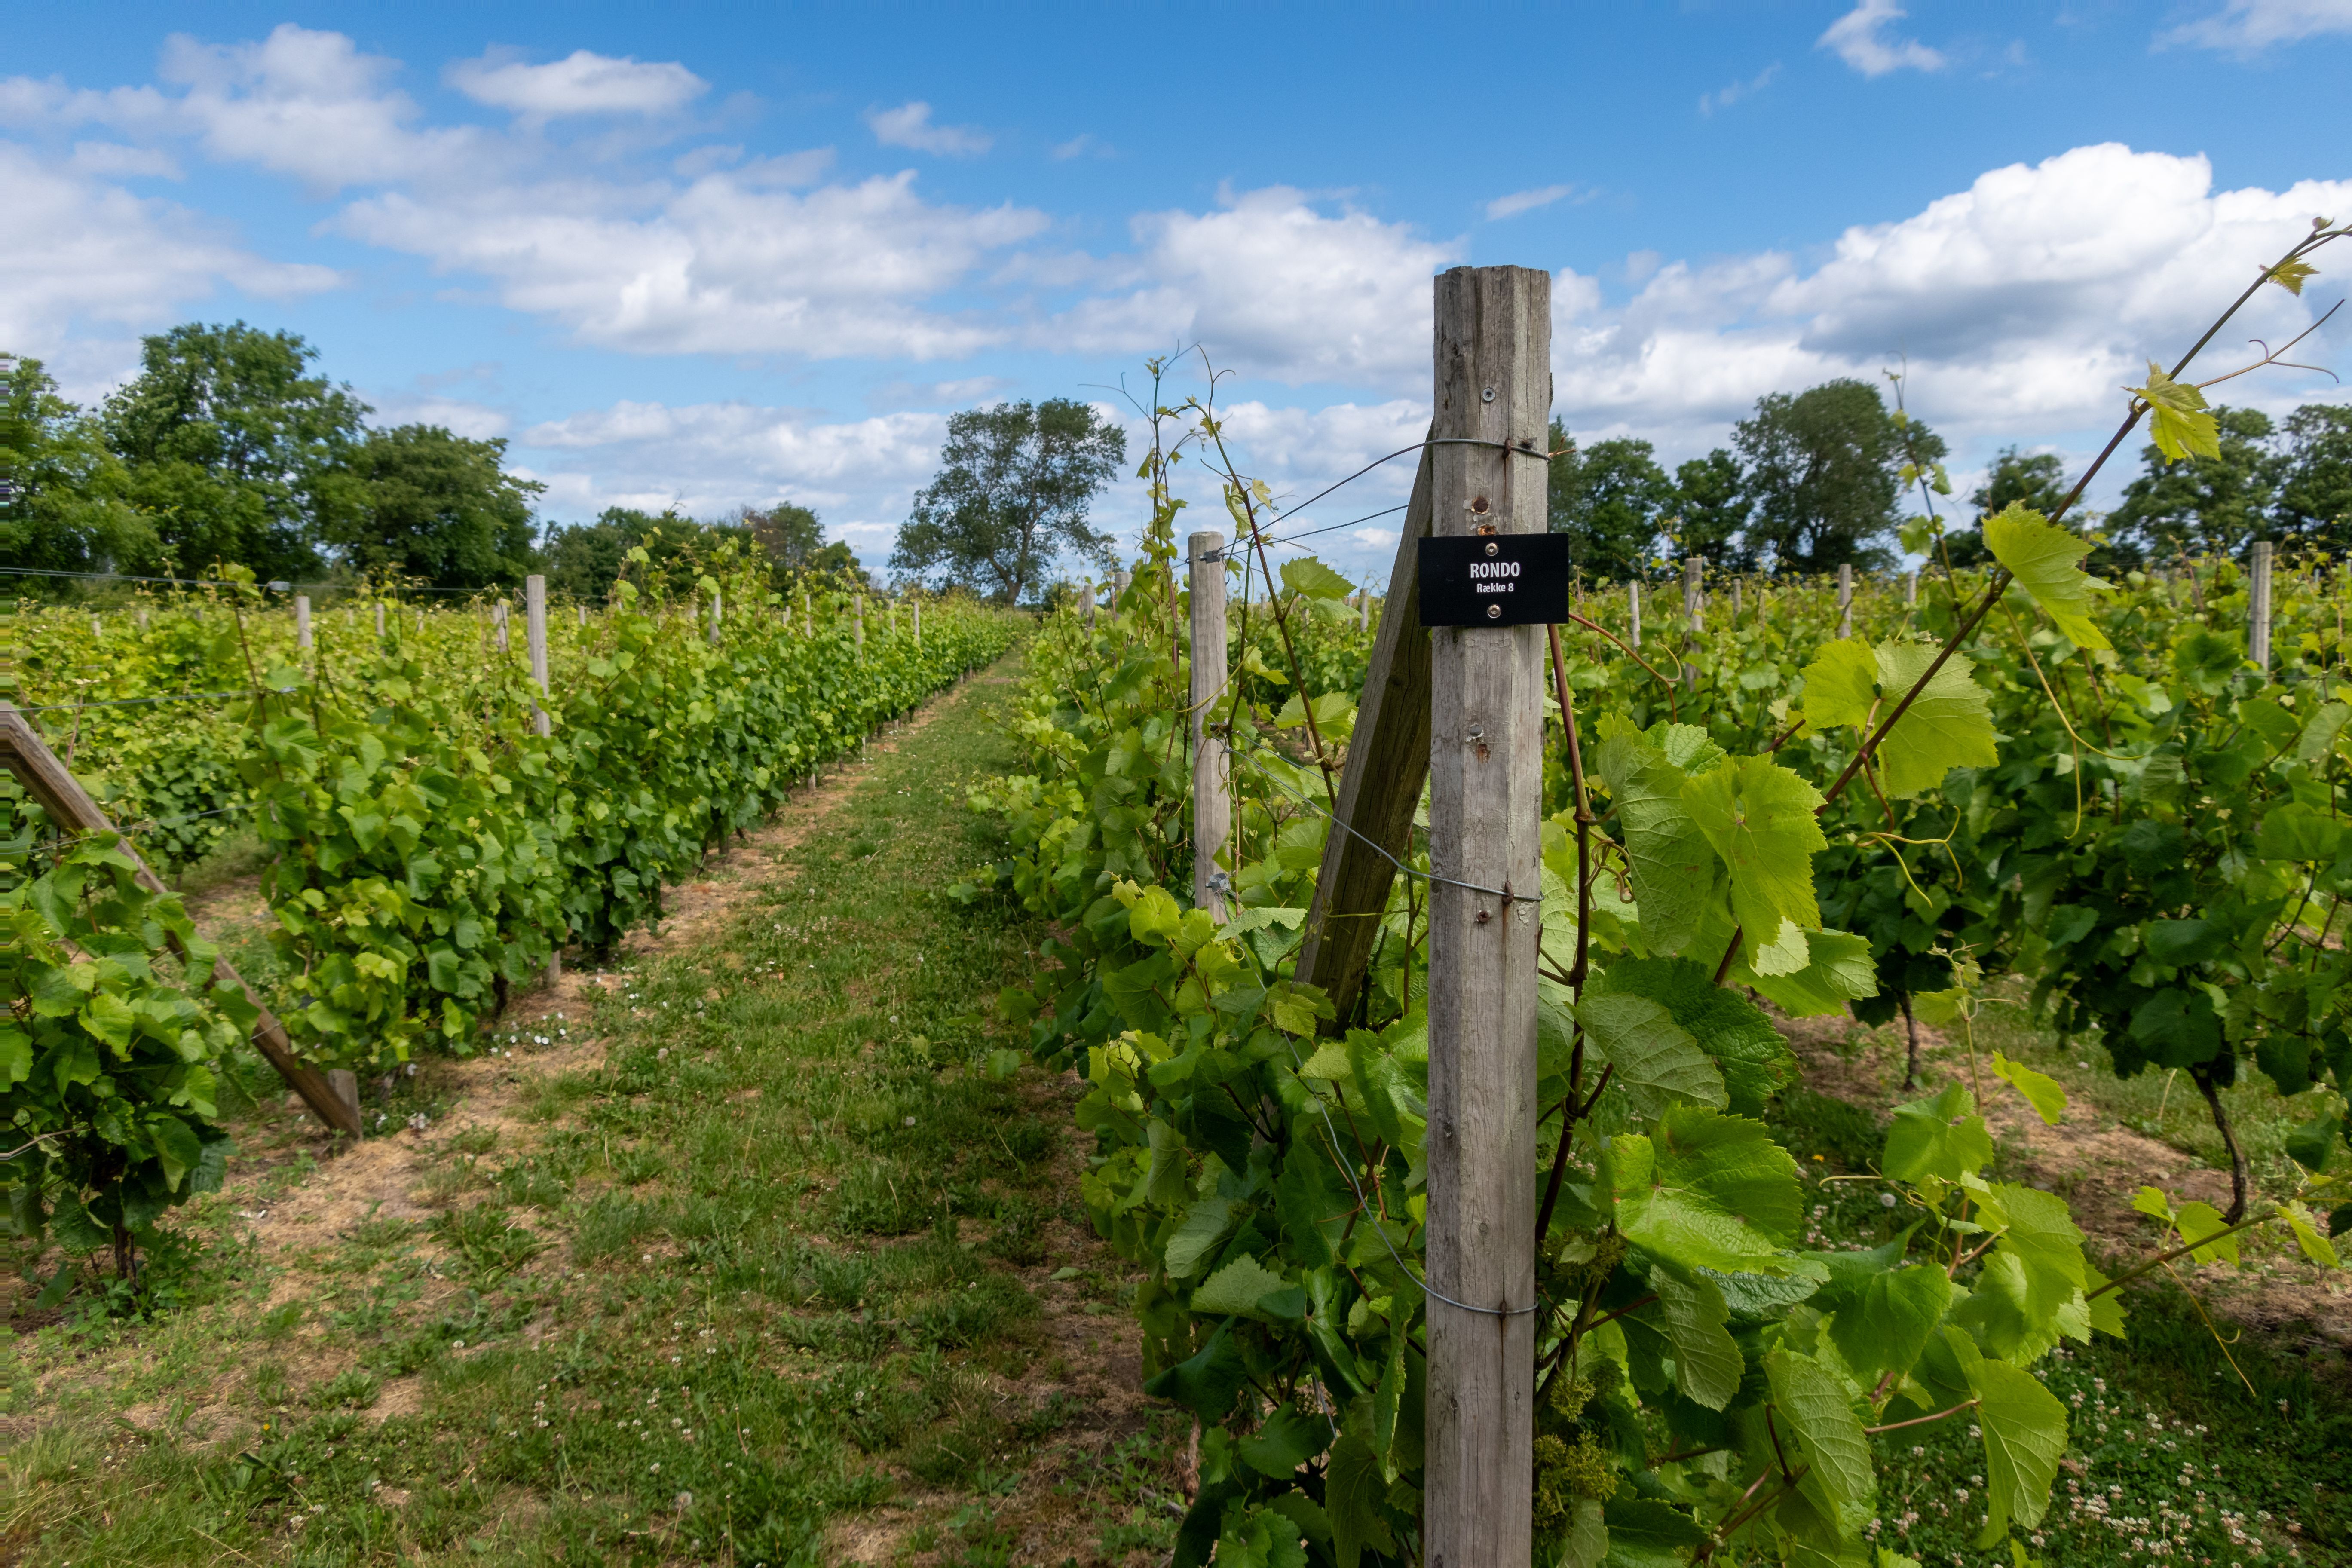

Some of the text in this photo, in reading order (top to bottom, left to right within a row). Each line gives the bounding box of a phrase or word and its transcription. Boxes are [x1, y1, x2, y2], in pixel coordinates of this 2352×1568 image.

[1470, 562, 1520, 578] RONDO
[1477, 582, 1513, 593] Række 8
